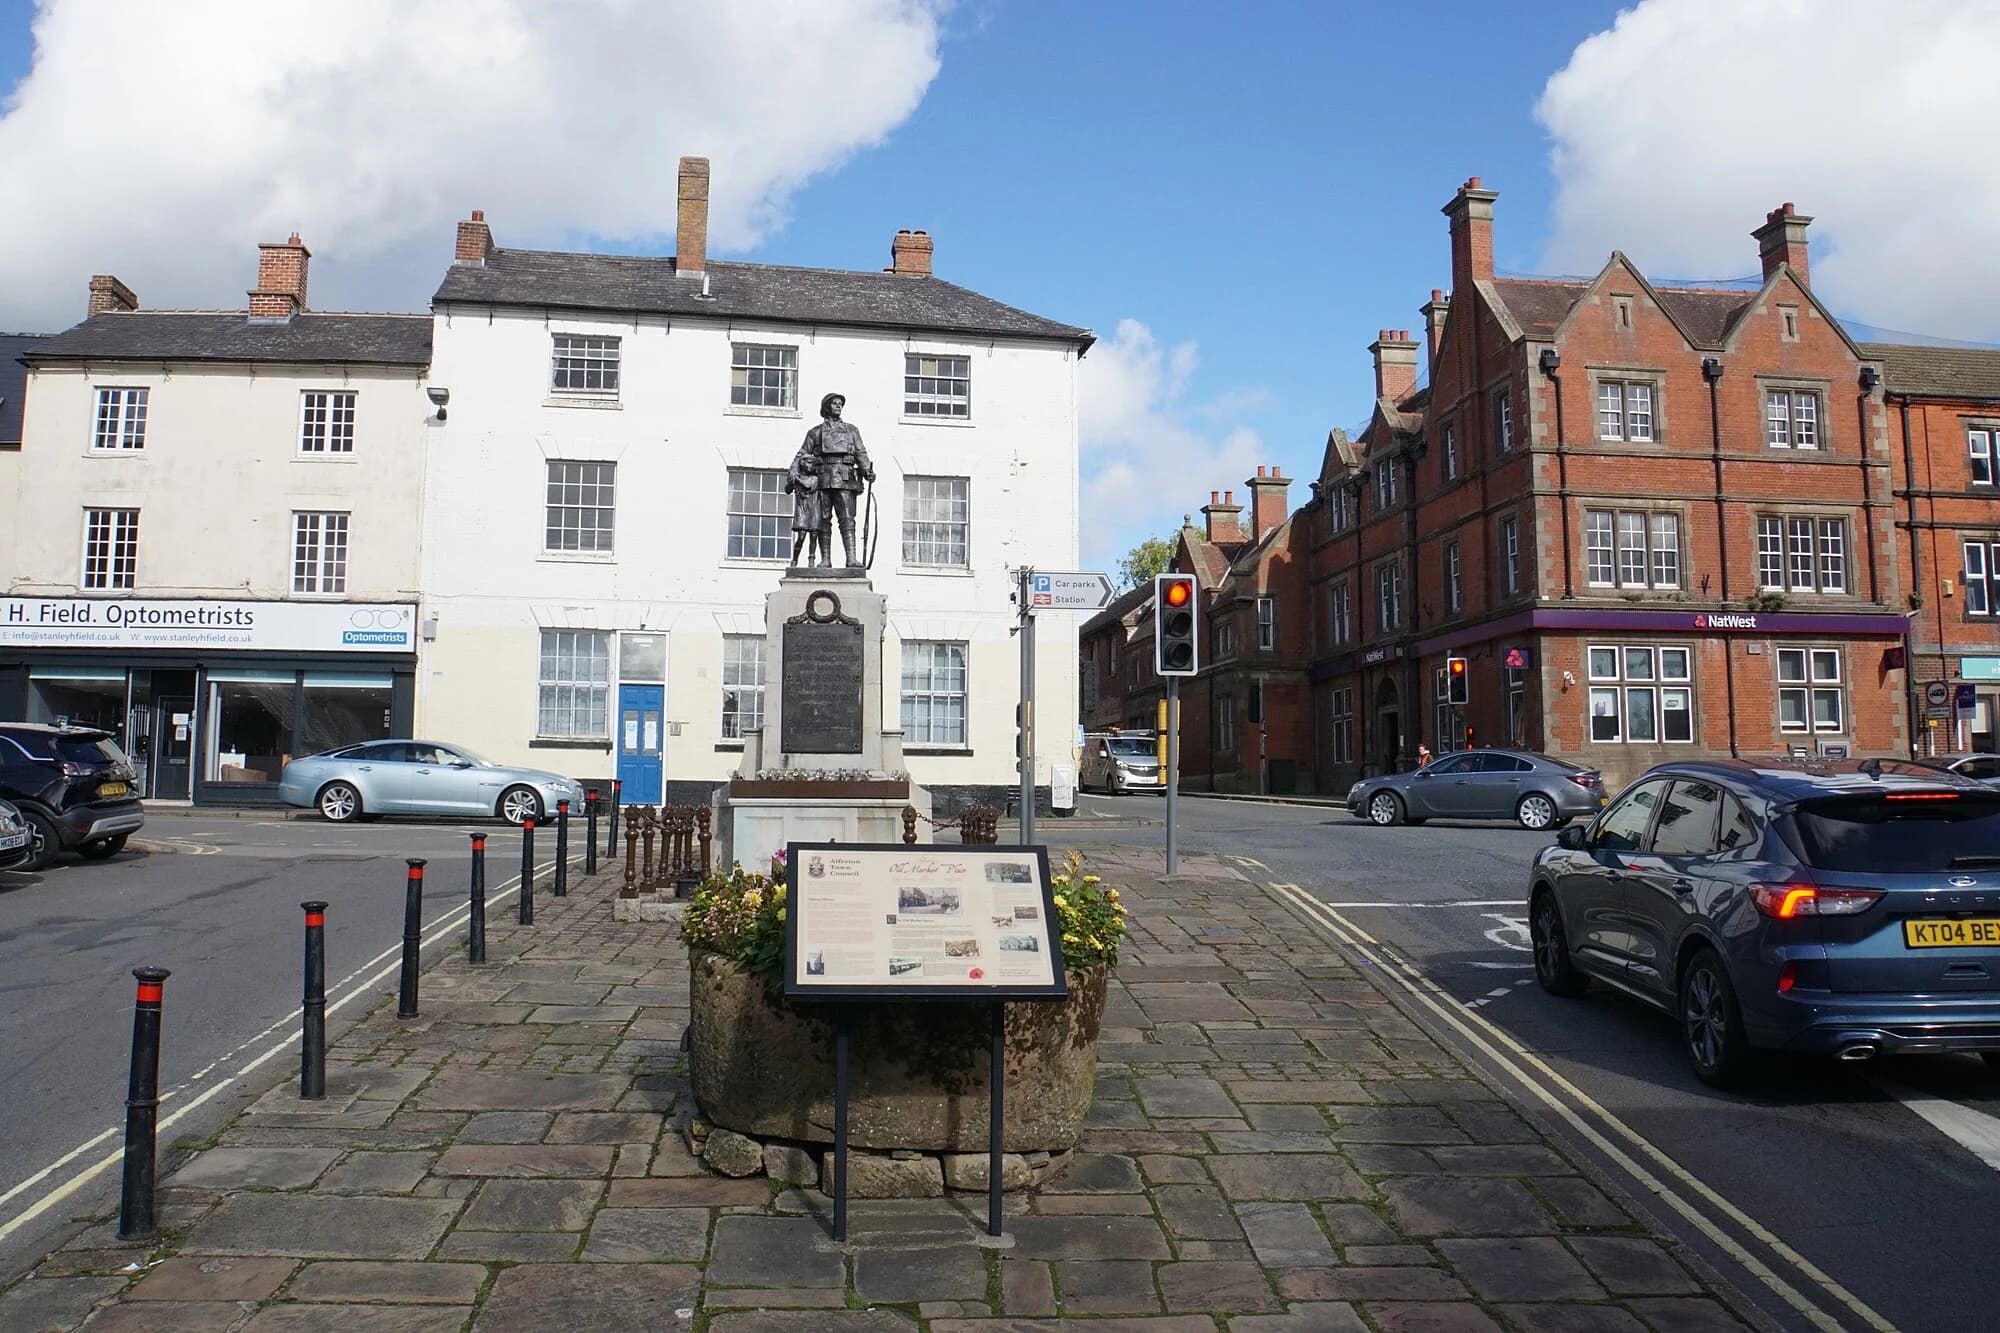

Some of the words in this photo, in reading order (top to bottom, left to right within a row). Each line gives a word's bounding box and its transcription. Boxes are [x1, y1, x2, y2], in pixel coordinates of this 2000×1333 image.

[1055, 580, 1070, 588] Car
[1072, 581, 1096, 589] parks
[1055, 595, 1086, 604] Station
[9, 603, 30, 622] H.
[40, 603, 97, 623] Field.
[106, 605, 254, 628] Optometrists
[1708, 614, 1757, 628] NatWest
[12, 631, 121, 642] info@stanleyhfield.co.uk
[144, 633, 254, 644] www.stanleyhfield.co.uk
[345, 632, 405, 643] Optometrists
[1914, 924, 1966, 943] KT04
[1971, 923, 2000, 942] BE
